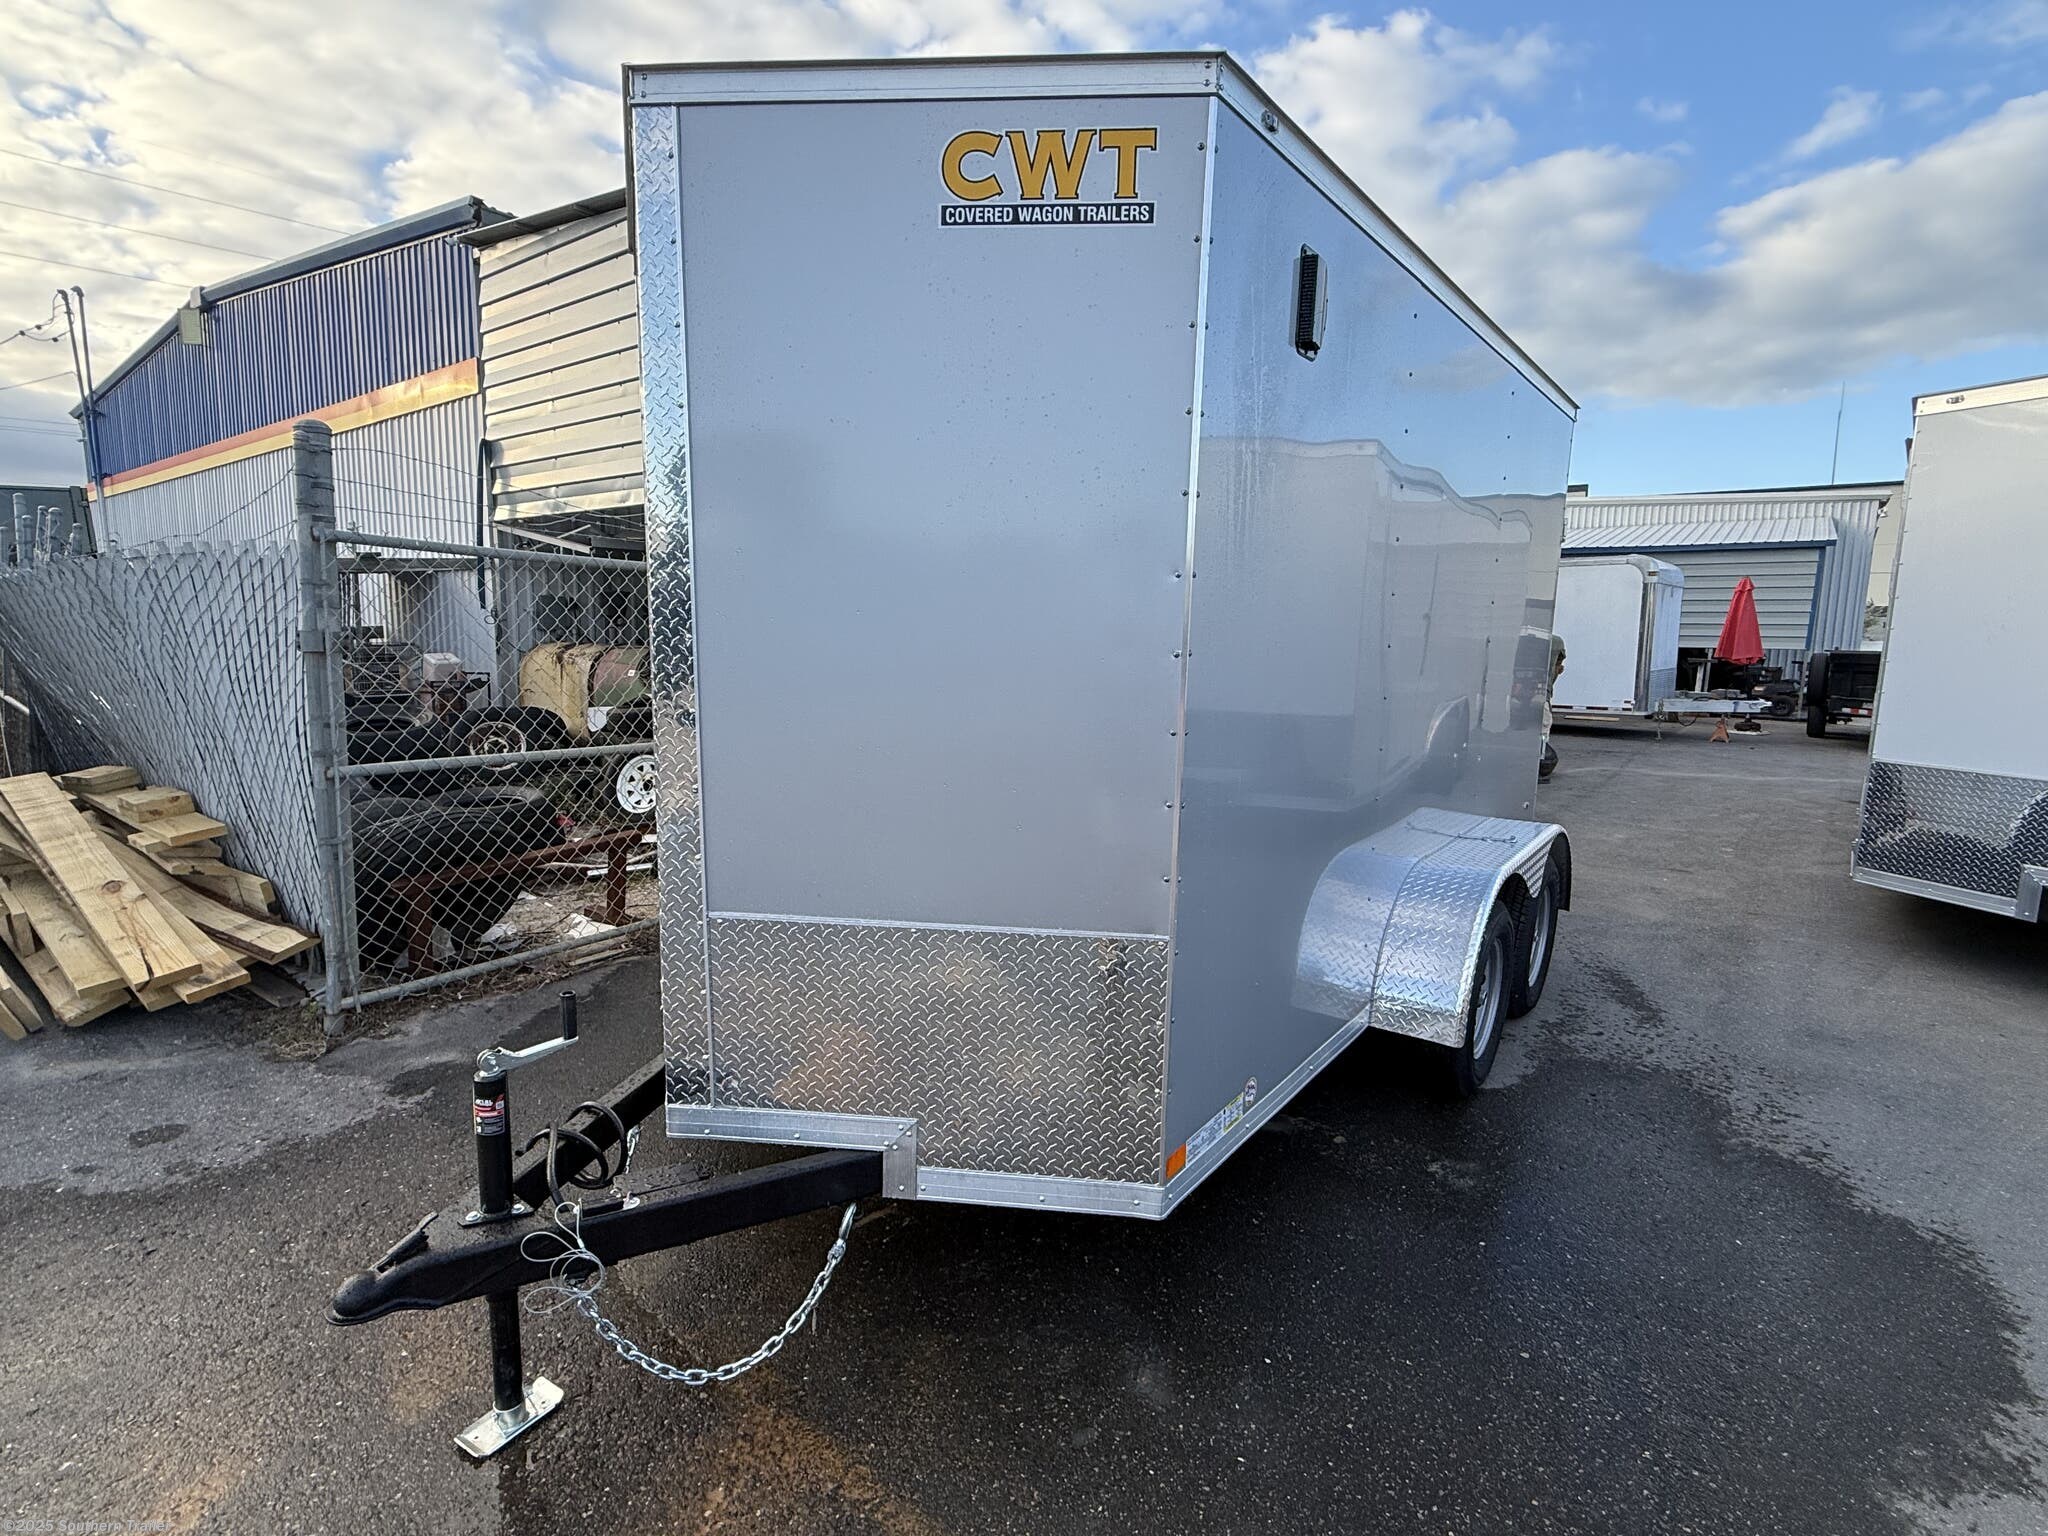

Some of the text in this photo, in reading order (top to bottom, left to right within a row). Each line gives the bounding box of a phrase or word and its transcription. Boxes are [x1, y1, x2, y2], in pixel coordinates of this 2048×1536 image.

[941, 127, 1158, 202] CWT
[945, 204, 1150, 223] COVERED WAGON TRAILERS
